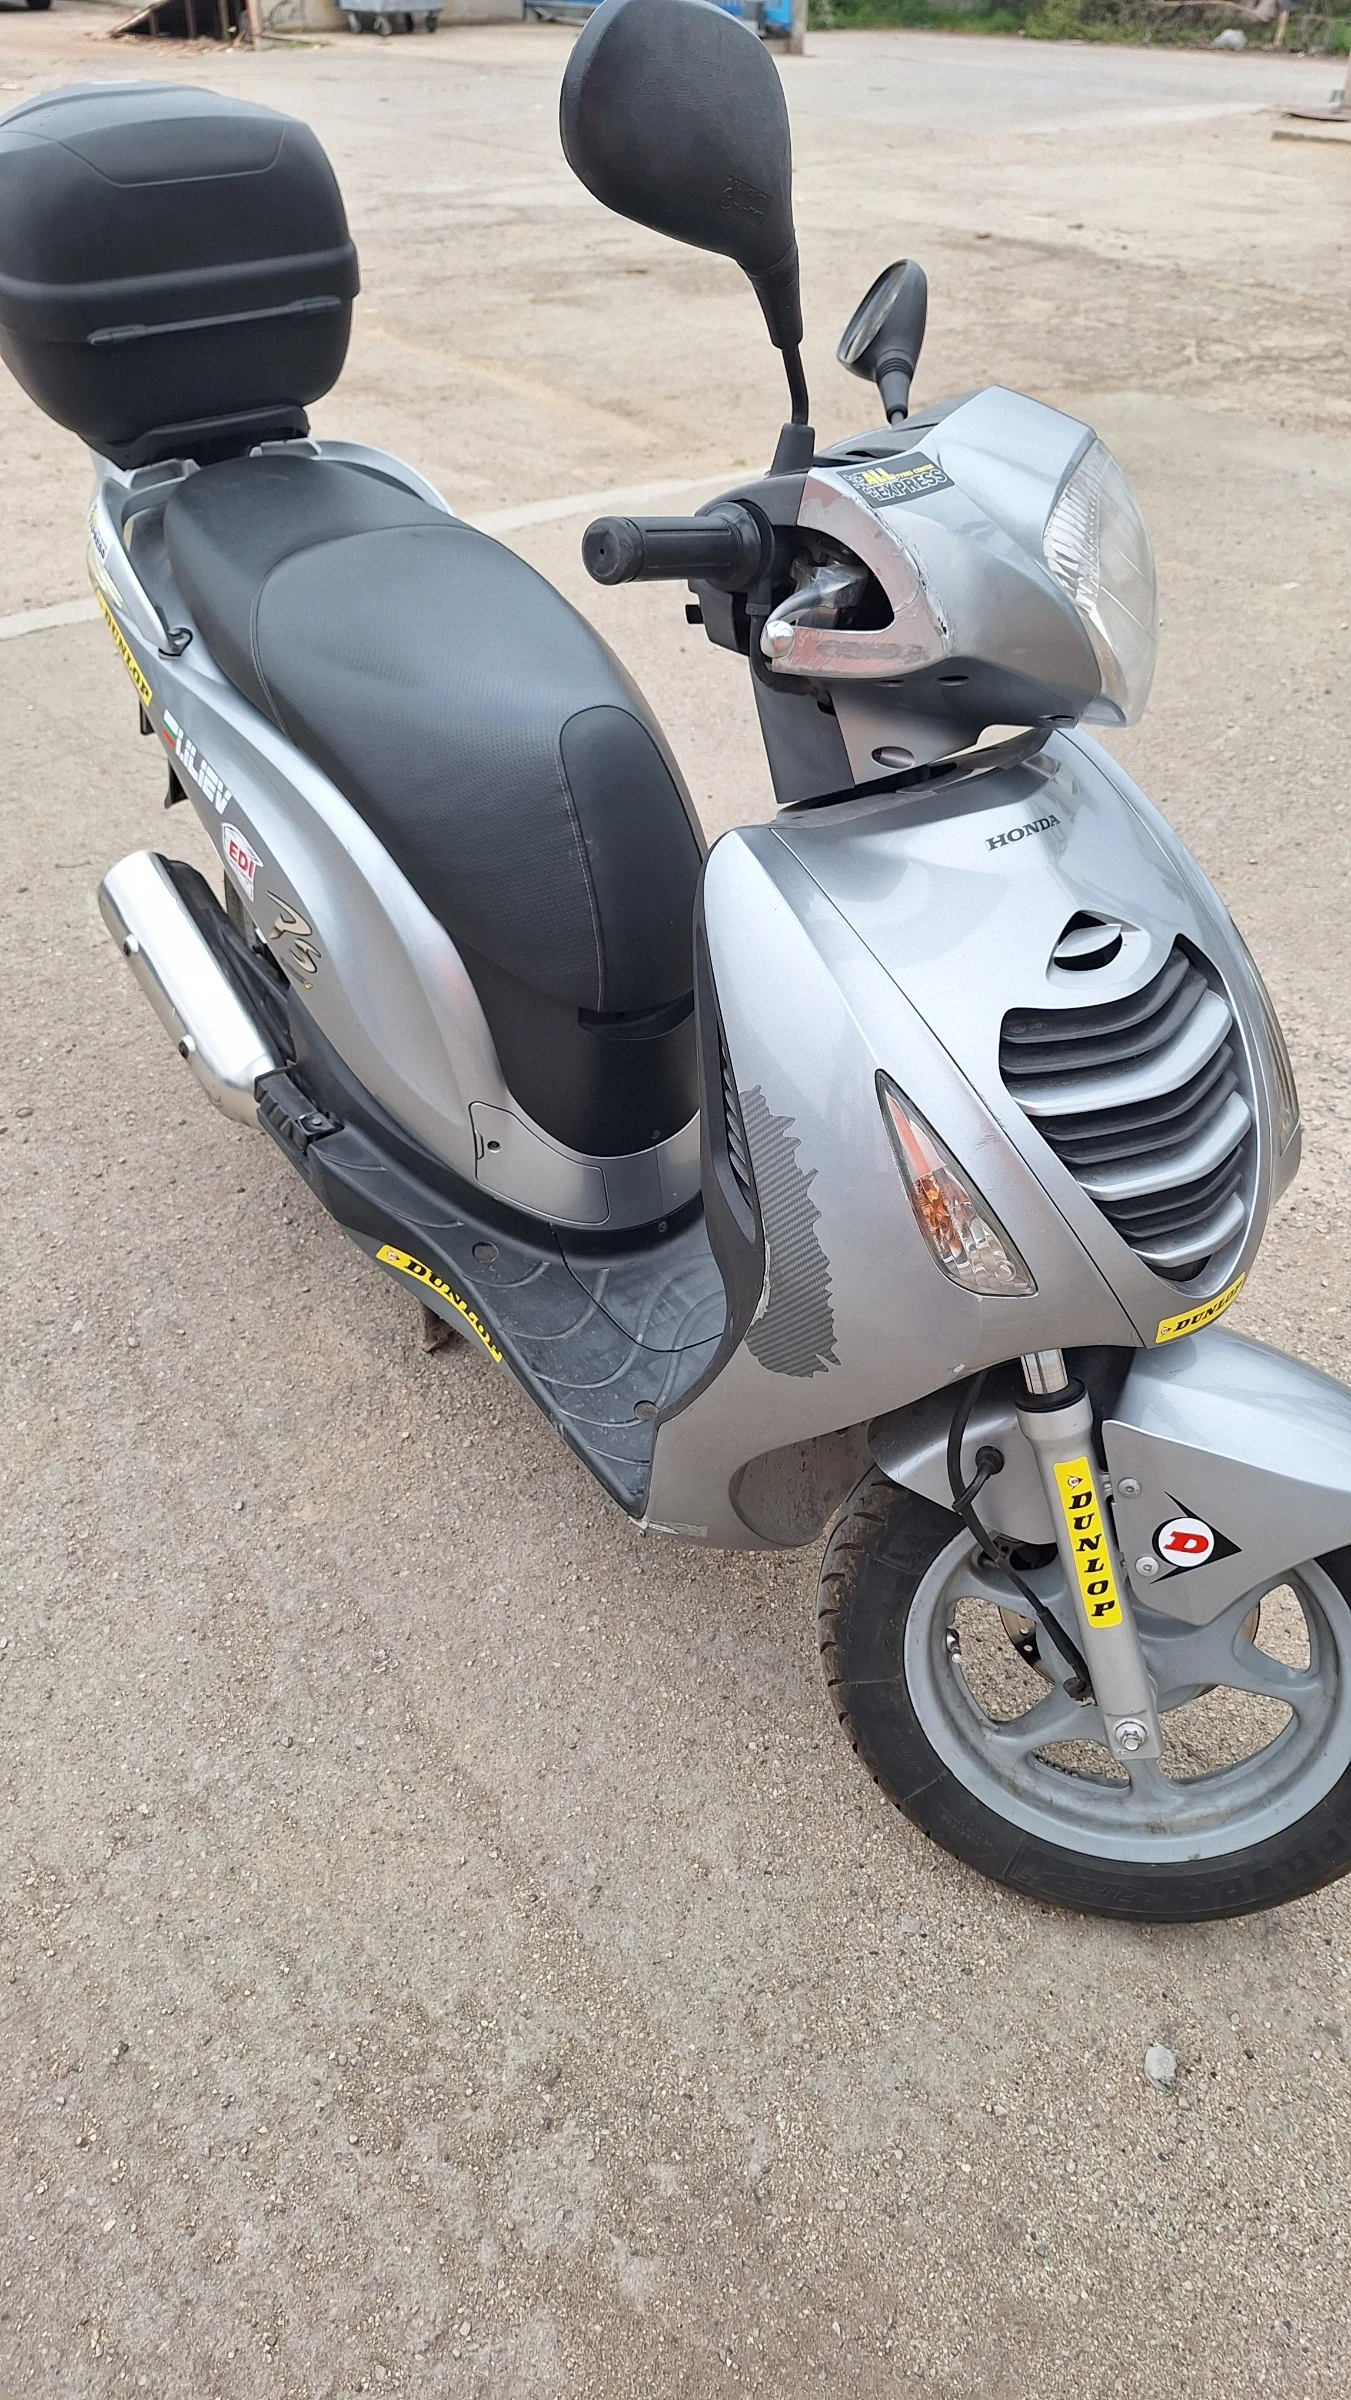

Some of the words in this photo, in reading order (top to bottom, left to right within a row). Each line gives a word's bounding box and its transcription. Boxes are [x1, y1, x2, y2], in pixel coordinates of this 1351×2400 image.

[861, 467, 895, 486] ALL
[876, 469, 947, 501] EXPRESS
[986, 815, 1061, 851] HONDA
[229, 840, 255, 879] EDI
[404, 1259, 502, 1357] DUNLOP
[1173, 1280, 1243, 1332] DUNLOP
[1068, 1491, 1115, 1617] DUNLOP
[1163, 1531, 1209, 1554] D
